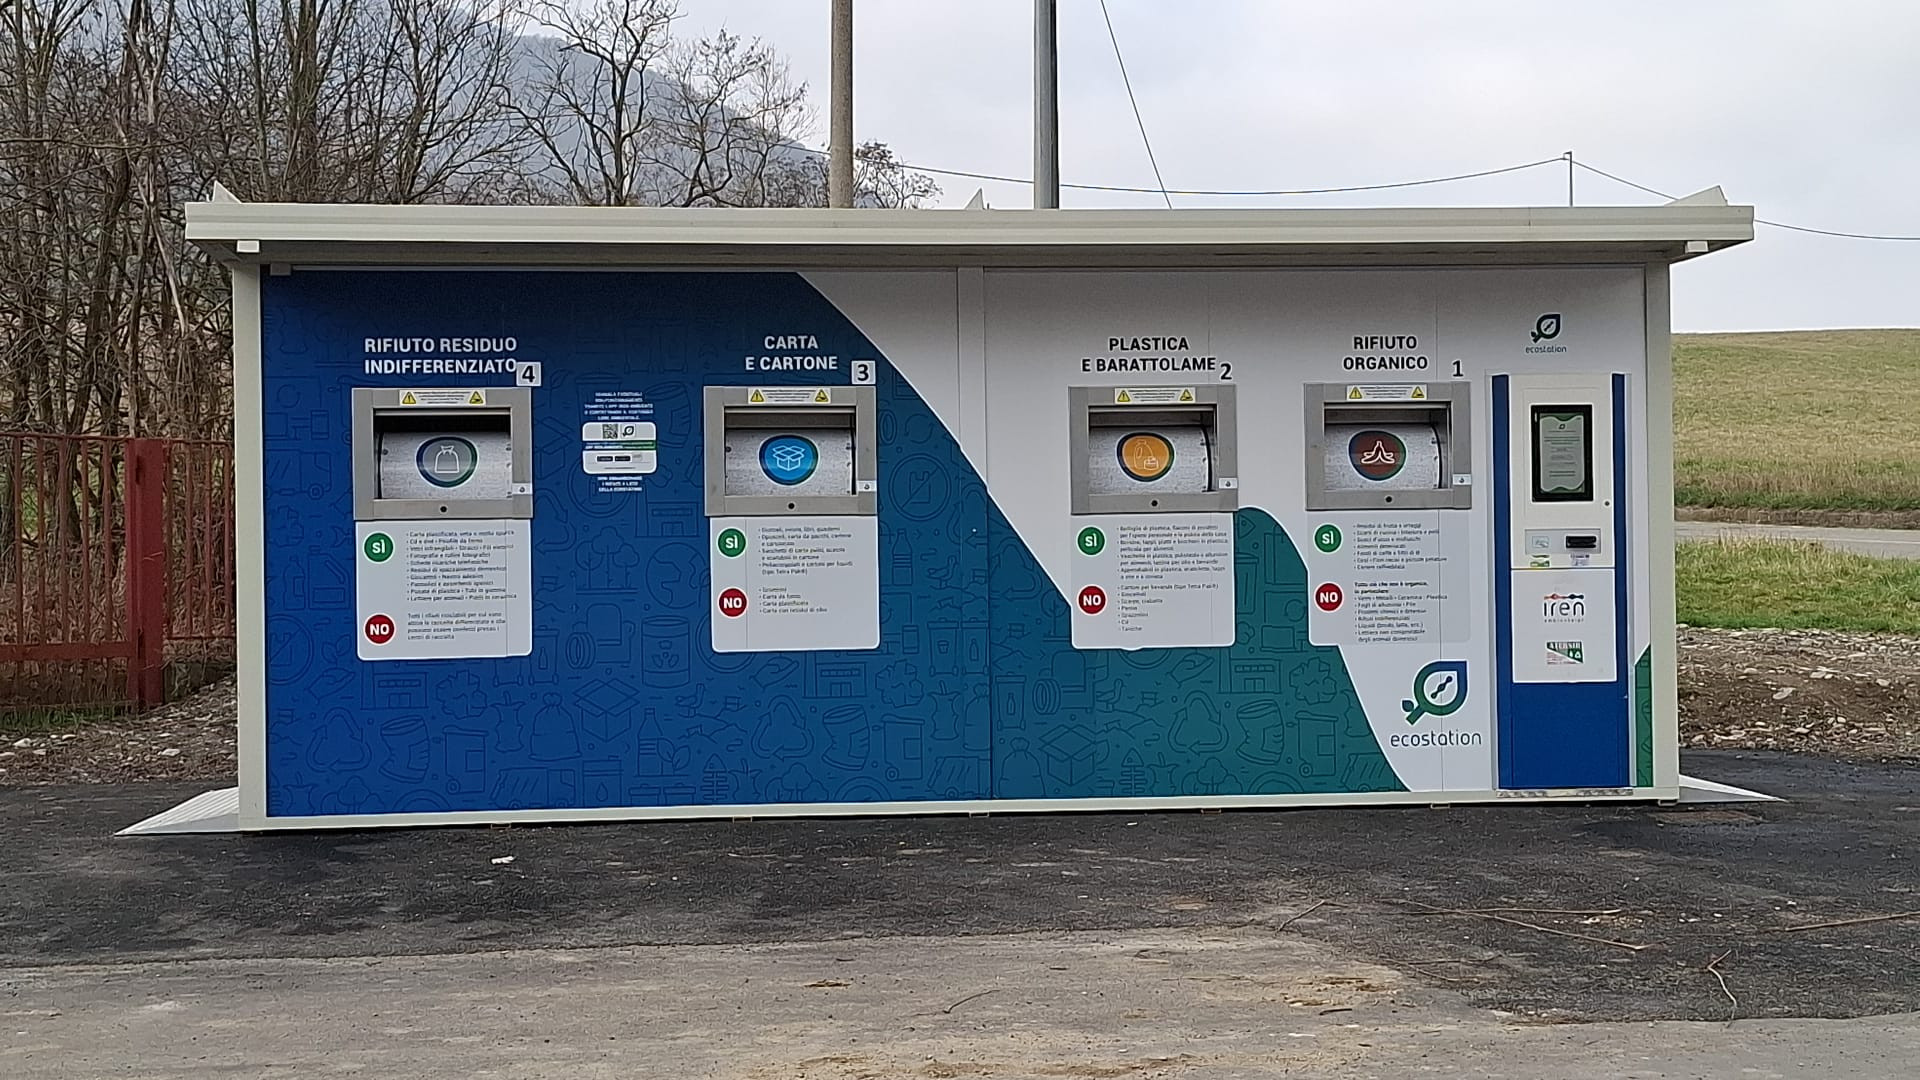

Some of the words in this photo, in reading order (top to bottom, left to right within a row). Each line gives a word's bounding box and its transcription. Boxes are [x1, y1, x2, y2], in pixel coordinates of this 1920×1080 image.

[365, 338, 435, 353] RIFIUTO
[440, 337, 517, 352] RESIDUO
[764, 335, 819, 350] CARTA
[1109, 337, 1189, 351] PLASTICA
[1353, 336, 1418, 350] RIFIUTO
[365, 358, 517, 374] INDIFFERENZIATO
[745, 357, 755, 370] E
[760, 356, 838, 370] CARTONE
[1081, 358, 1091, 372] E
[1096, 357, 1216, 372] BARATTOLAME
[1343, 356, 1428, 370] ORGANICO
[1452, 360, 1464, 377] 1
[521, 365, 536, 383] 4
[857, 363, 869, 381] 3
[1220, 363, 1233, 380] 2
[723, 598, 742, 609] NO
[1083, 595, 1101, 606] NO
[1319, 592, 1339, 603] NO
[1544, 601, 1585, 617] iren
[369, 624, 390, 635] NO
[1390, 729, 1482, 747] ecostation
